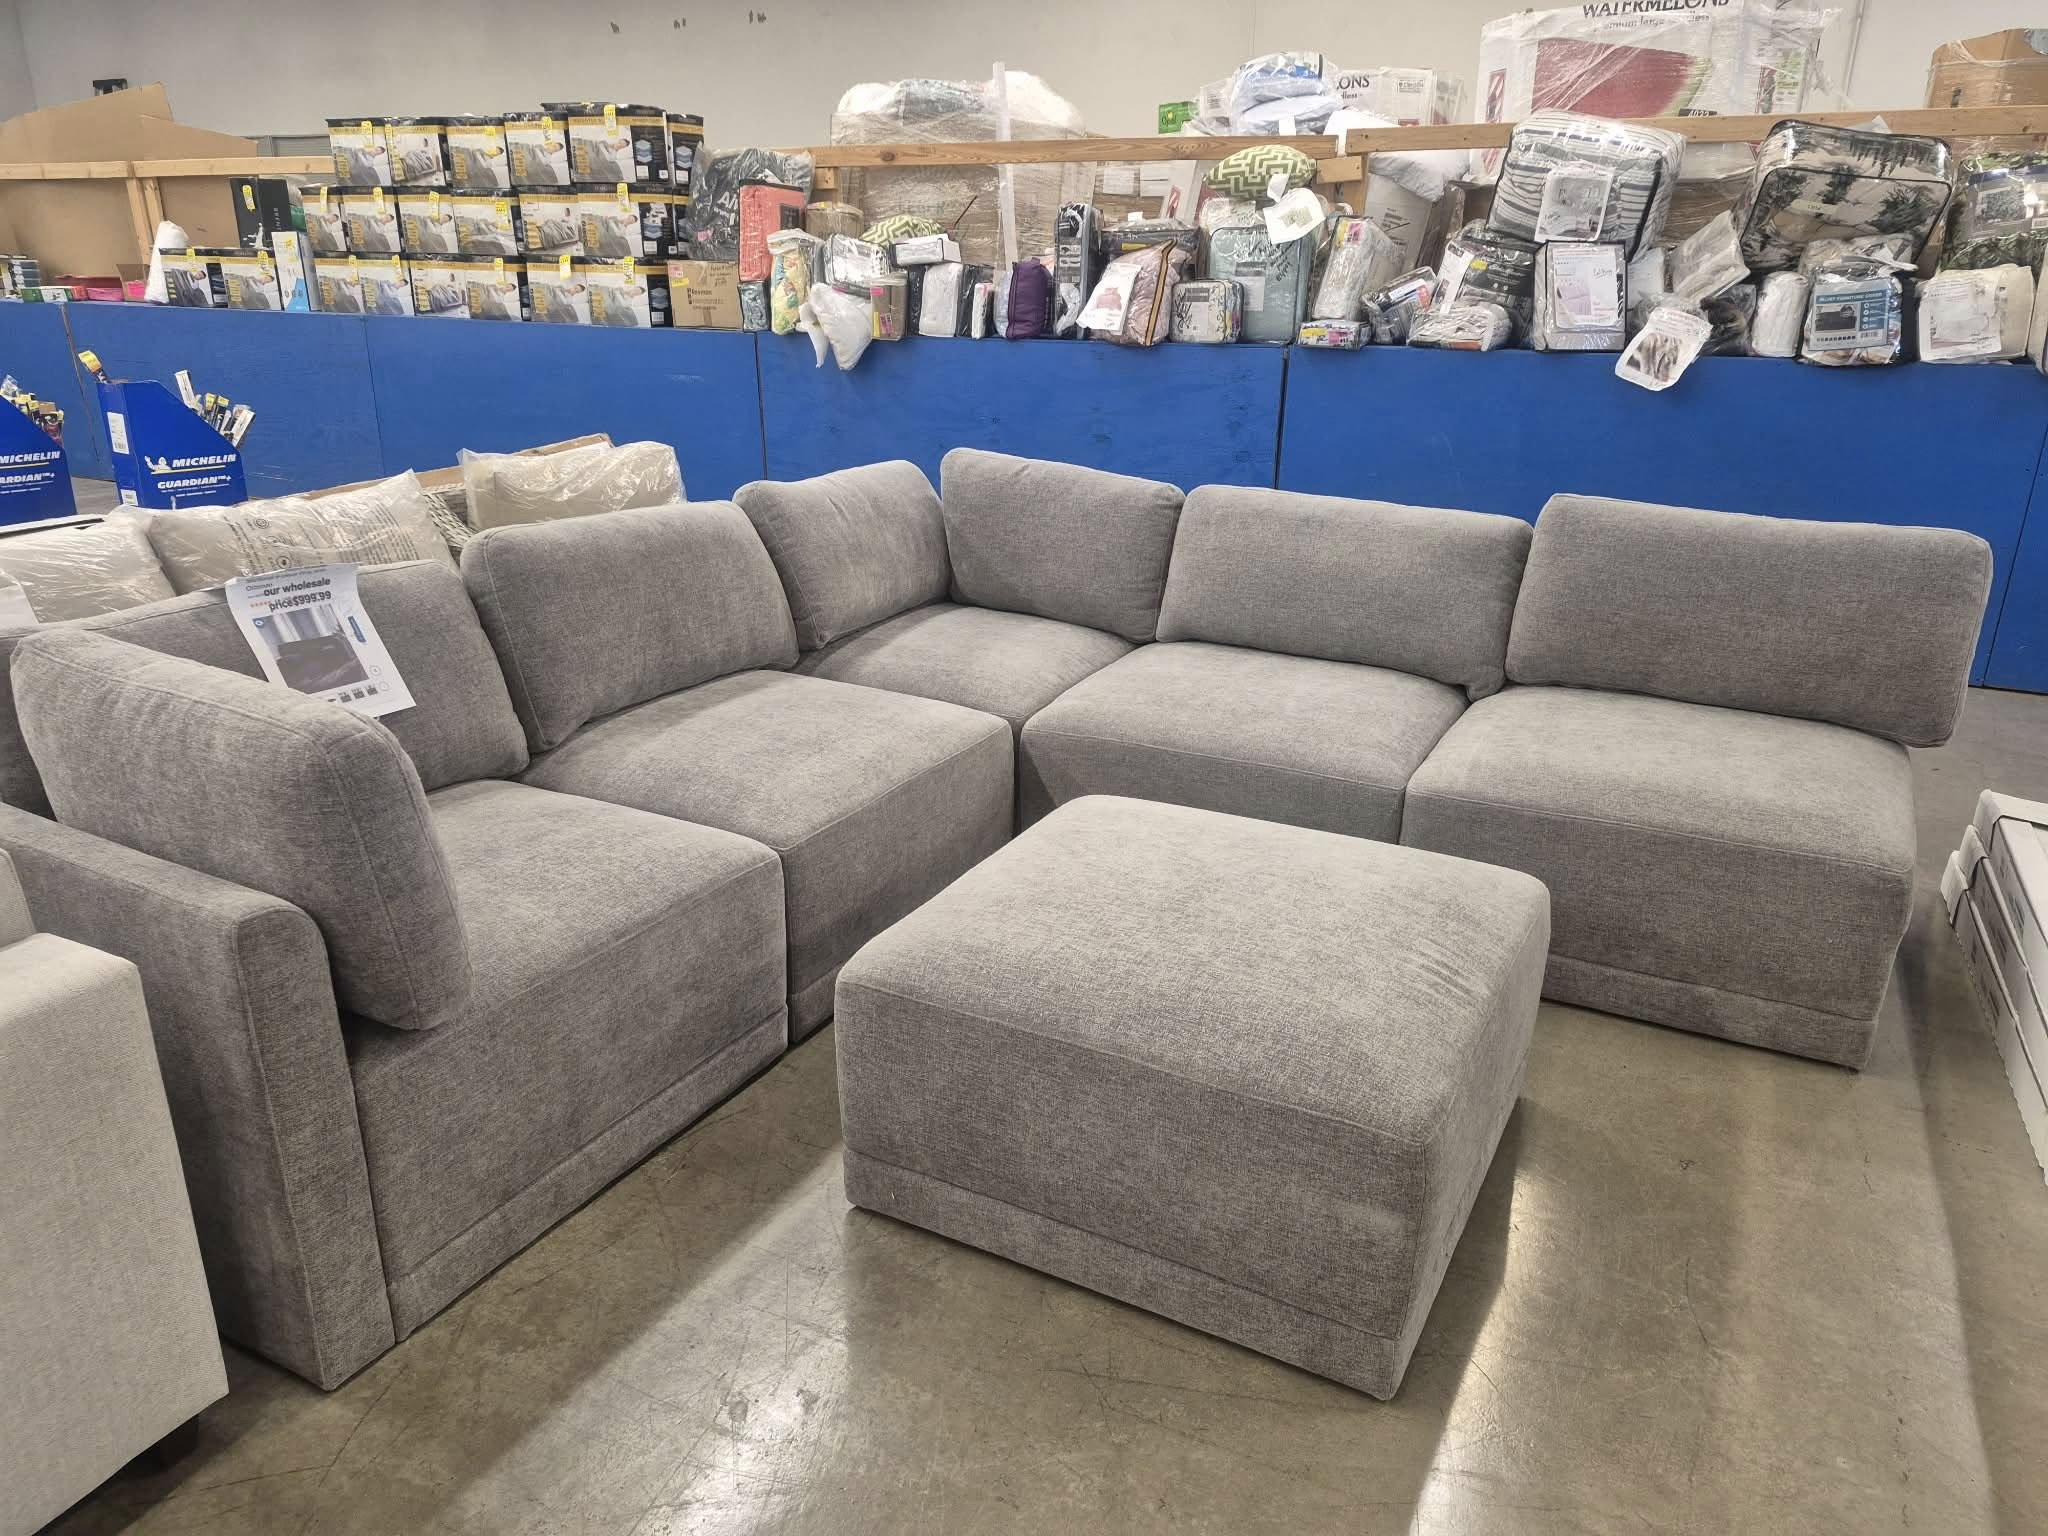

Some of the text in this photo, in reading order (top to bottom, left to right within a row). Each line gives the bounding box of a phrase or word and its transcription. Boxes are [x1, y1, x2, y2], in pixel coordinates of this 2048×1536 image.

[172, 454, 237, 468] MICHELIN
[263, 587, 280, 597] our
[282, 577, 331, 593] wholesale
